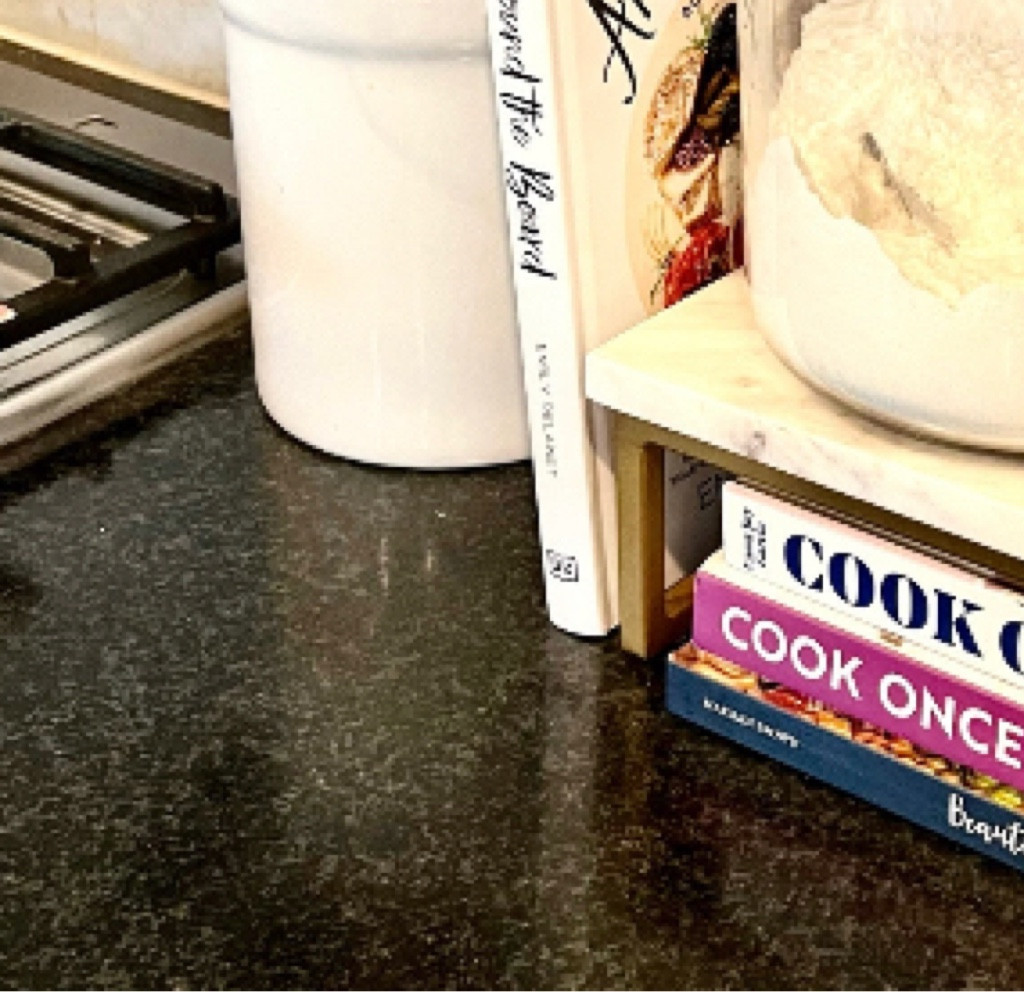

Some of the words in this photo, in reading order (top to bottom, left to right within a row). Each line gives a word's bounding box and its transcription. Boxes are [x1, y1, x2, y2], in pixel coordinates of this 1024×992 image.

[505, 153, 558, 281] Board
[721, 606, 864, 700] COOK
[783, 534, 985, 658] COOK
